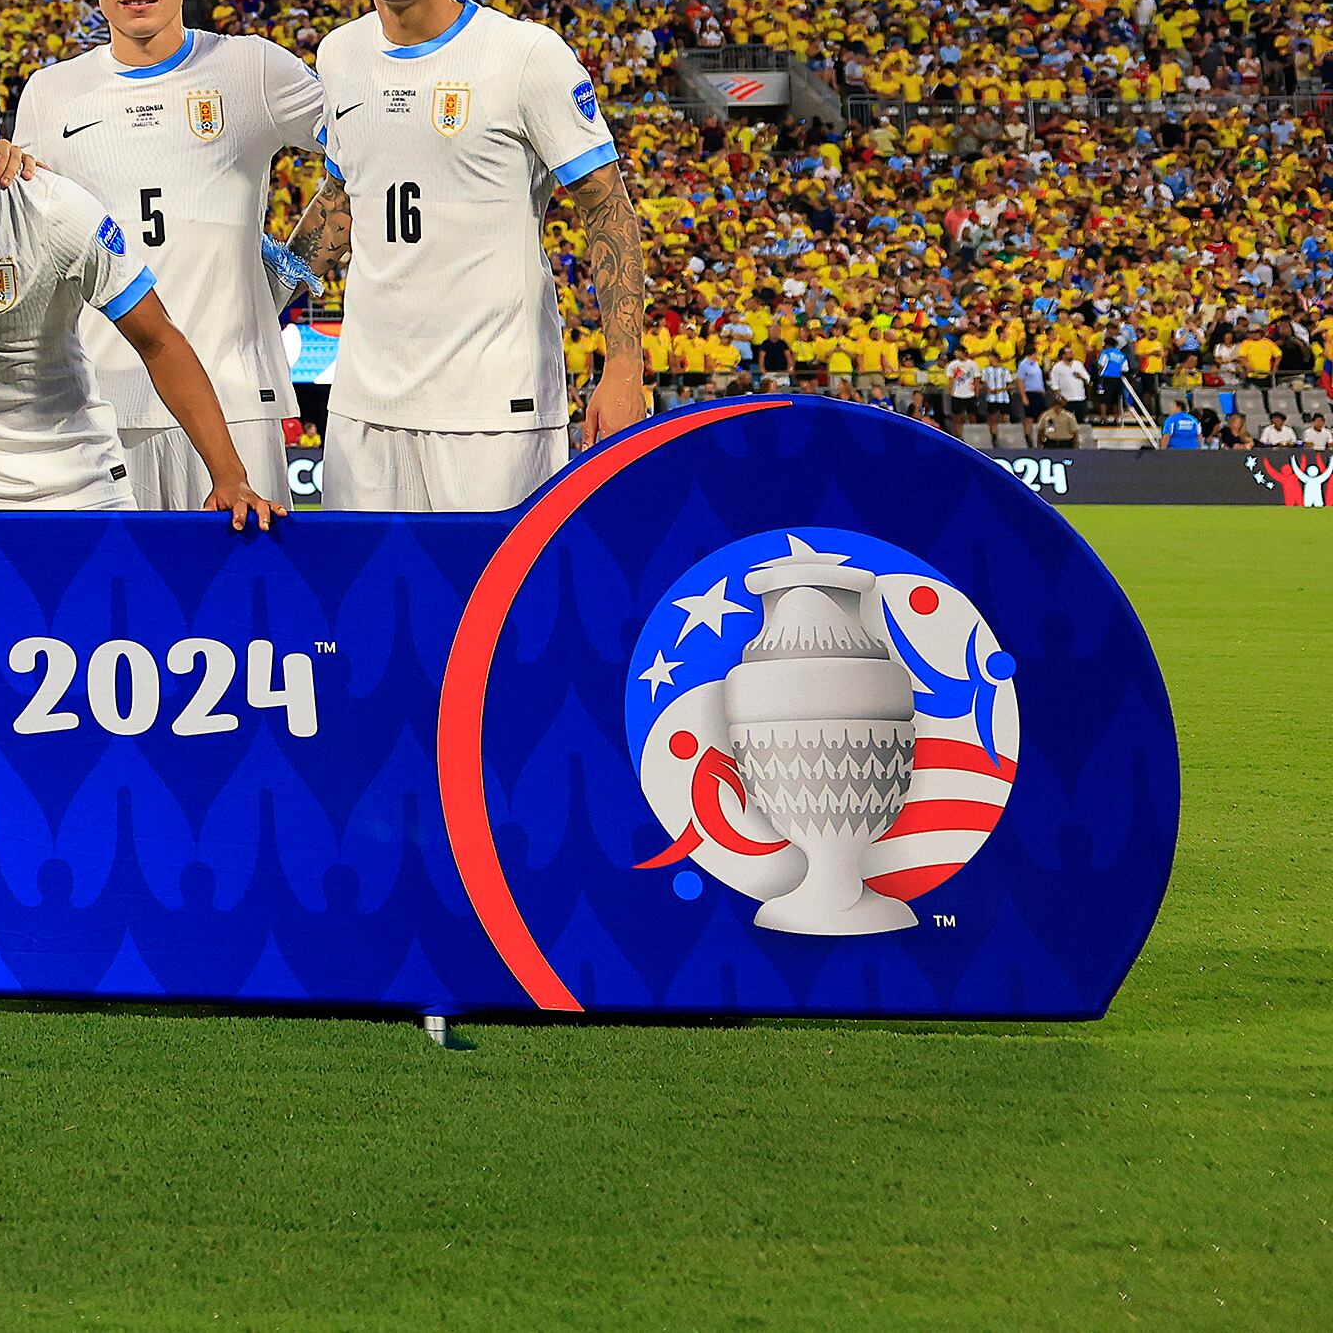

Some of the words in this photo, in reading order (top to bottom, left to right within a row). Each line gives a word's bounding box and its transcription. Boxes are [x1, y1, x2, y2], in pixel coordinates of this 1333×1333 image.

[135, 104, 164, 113] COLOMBIA
[140, 187, 166, 247] 5
[386, 182, 422, 244] 16
[8, 637, 319, 738] 2024
